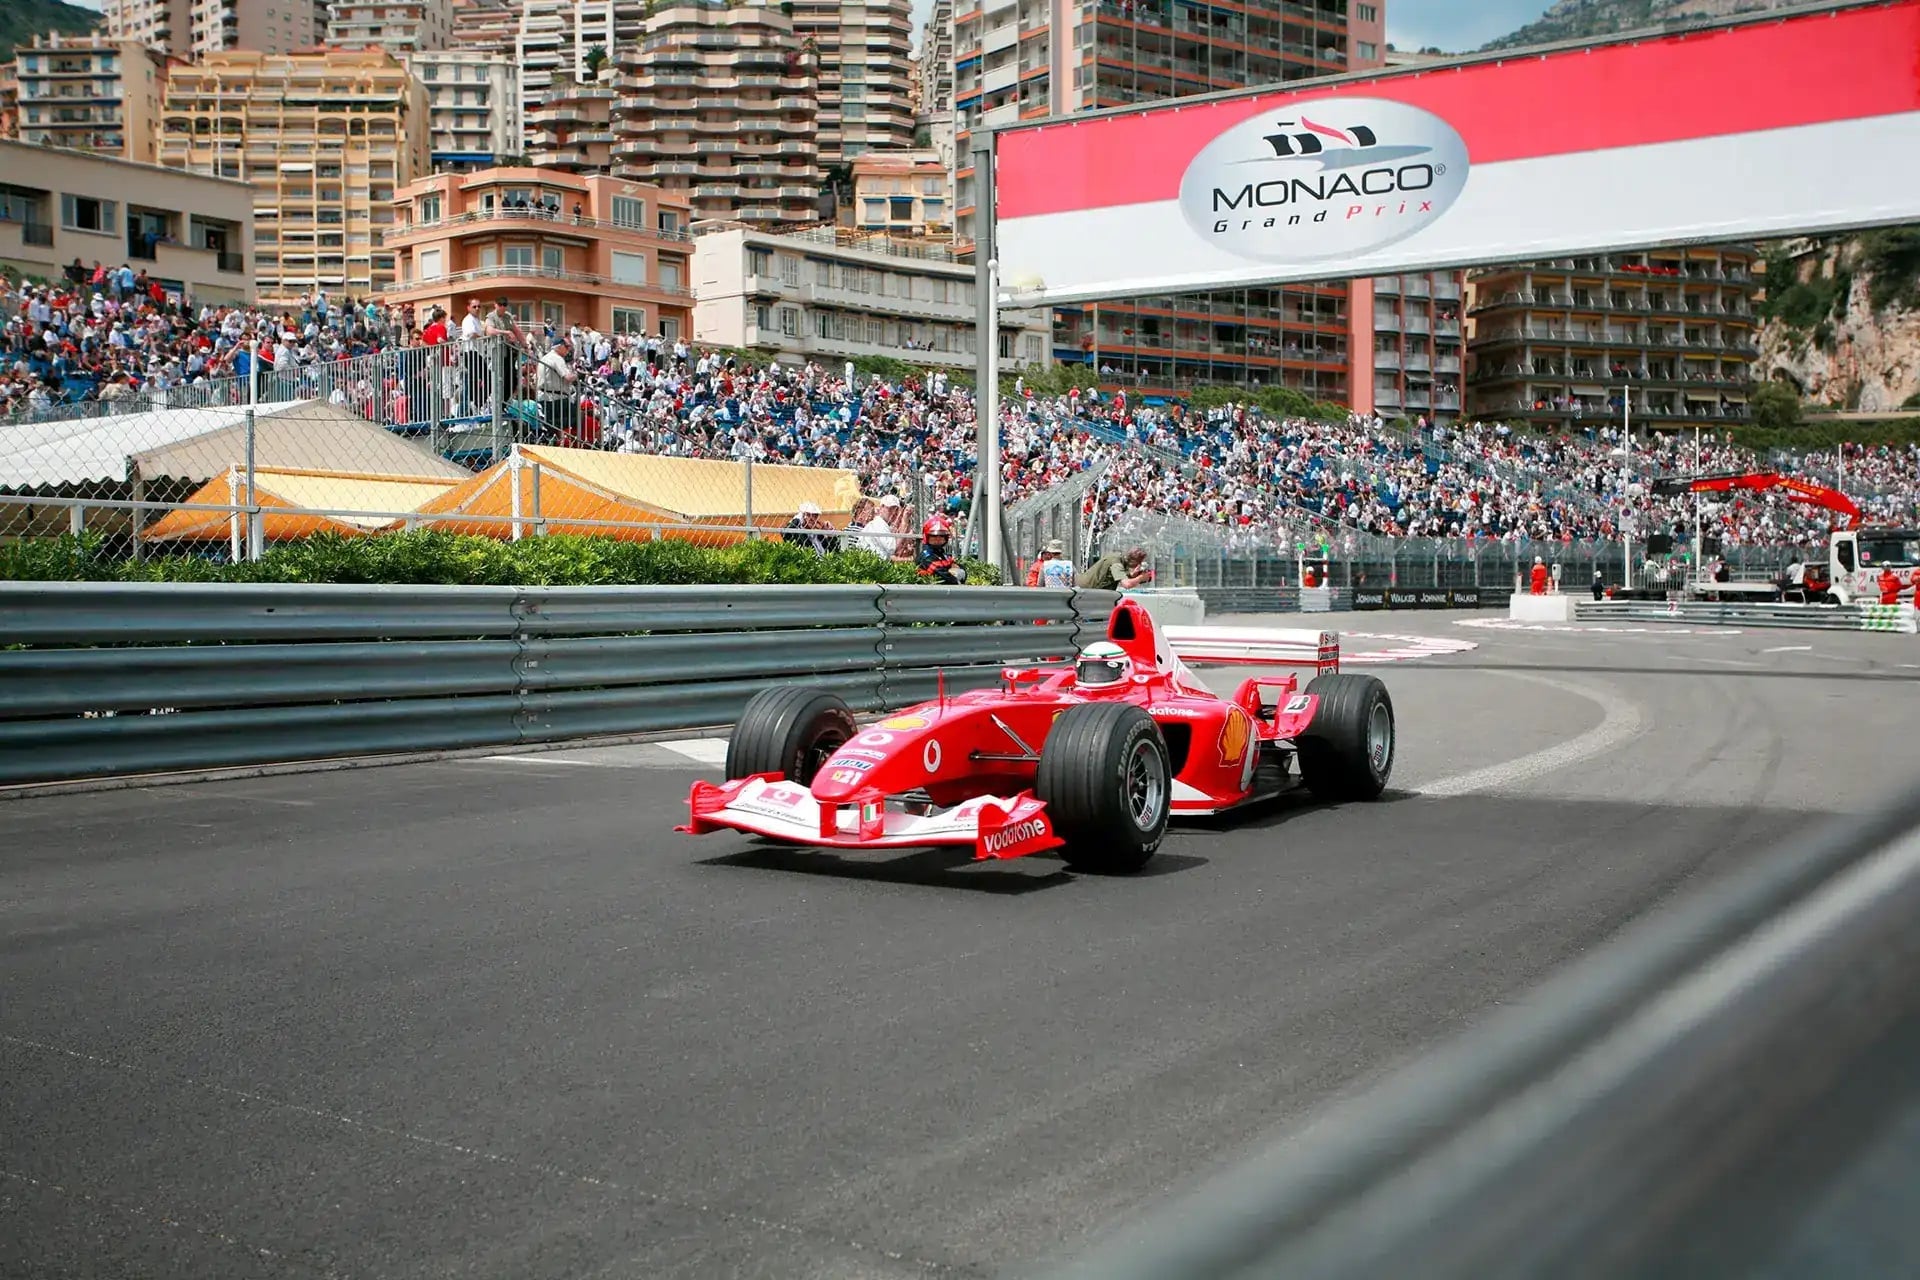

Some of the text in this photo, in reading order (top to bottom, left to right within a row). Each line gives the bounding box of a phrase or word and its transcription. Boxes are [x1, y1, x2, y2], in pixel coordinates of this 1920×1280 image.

[1213, 163, 1433, 212] MONACO
[1213, 200, 1432, 233] Grand Prix
